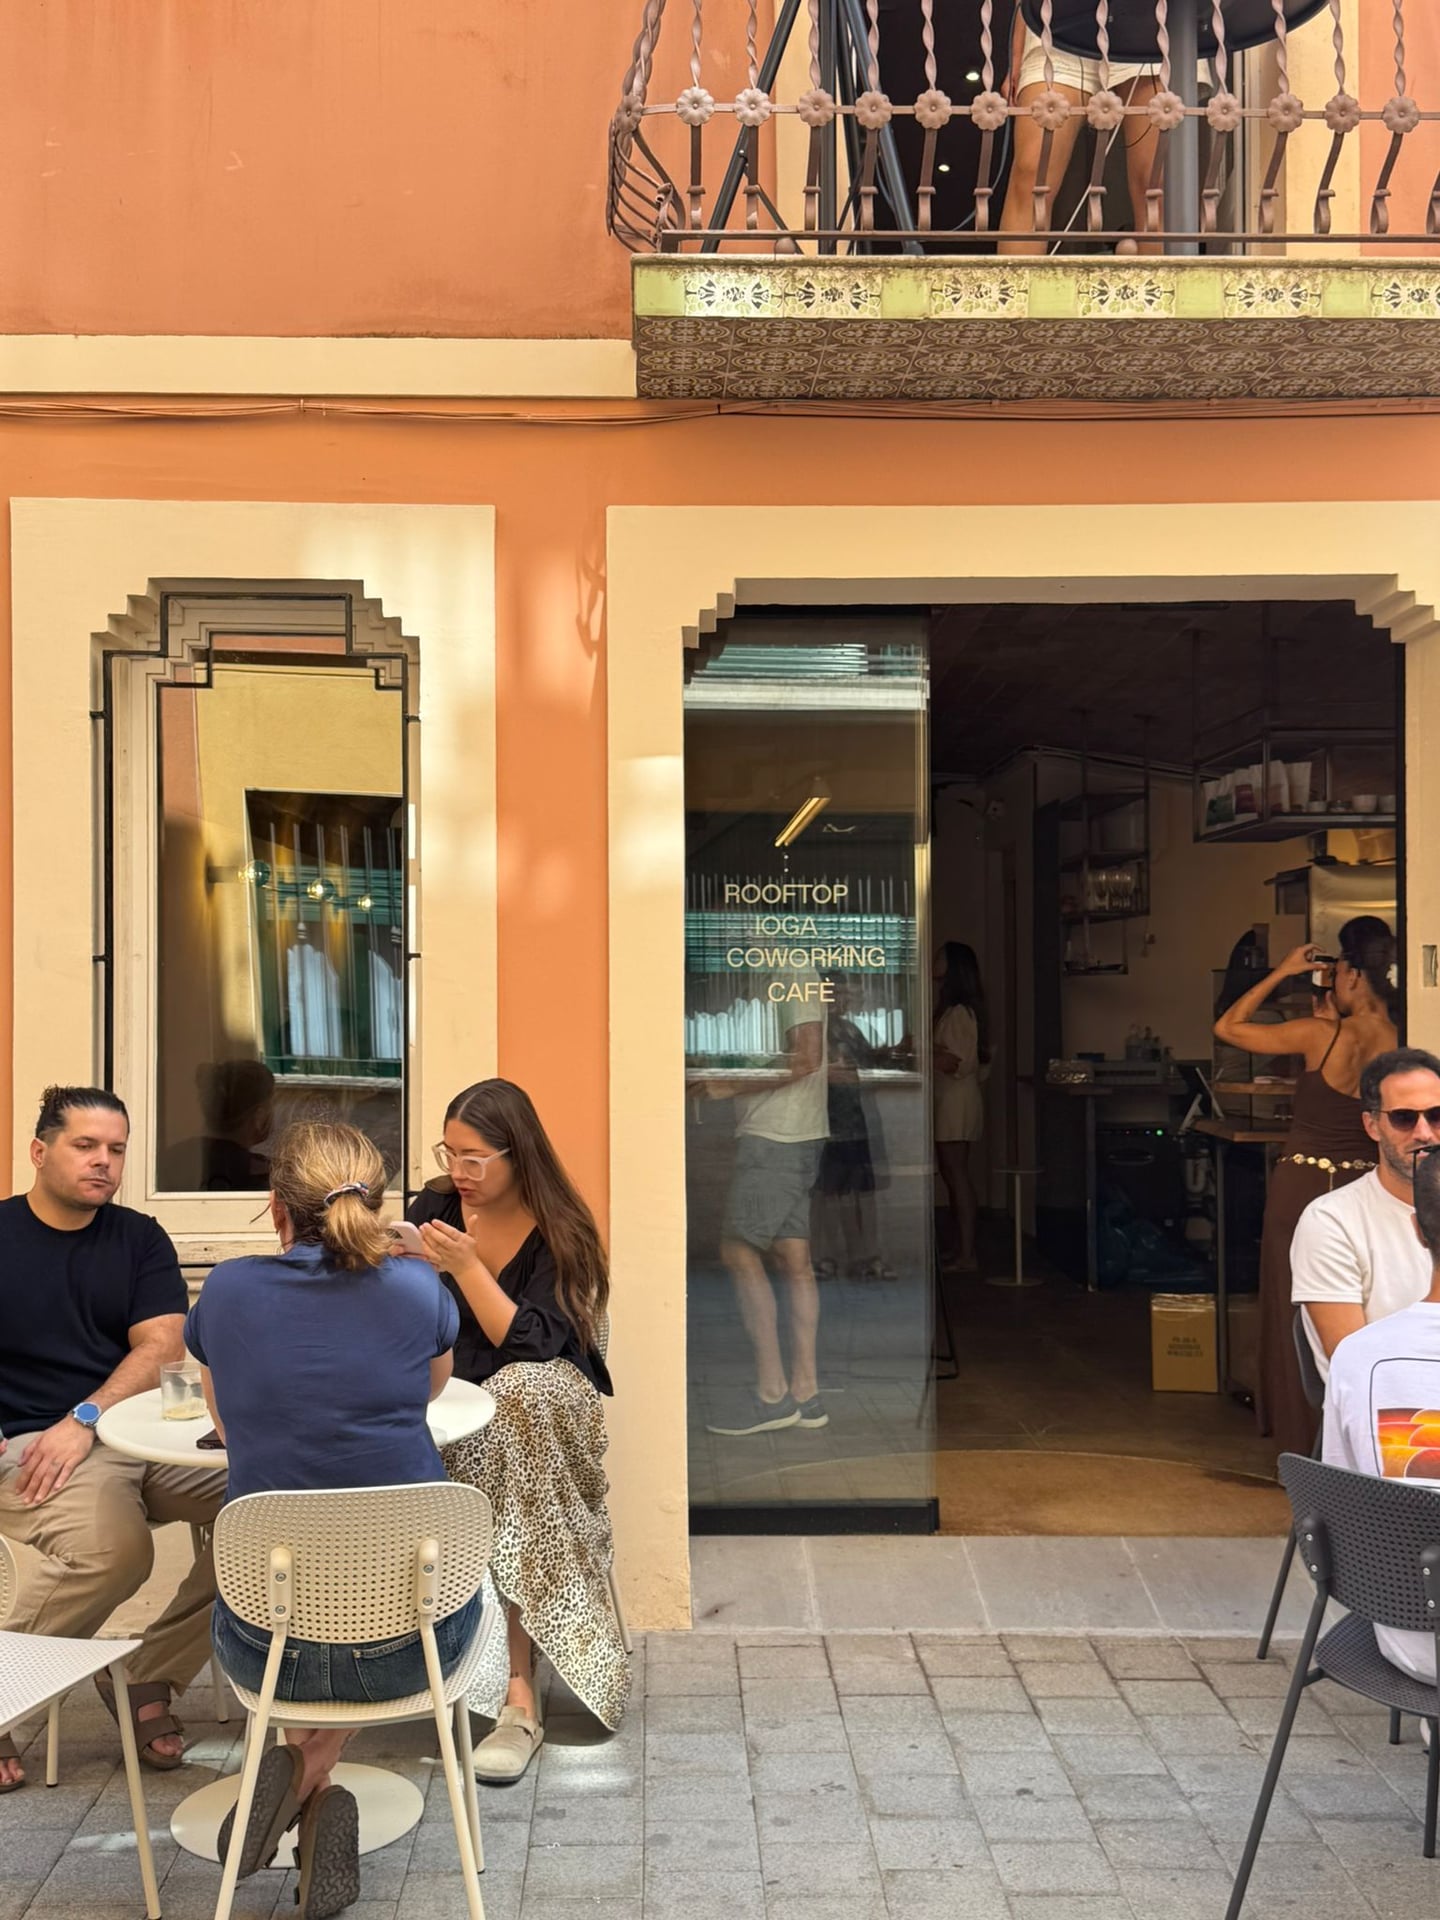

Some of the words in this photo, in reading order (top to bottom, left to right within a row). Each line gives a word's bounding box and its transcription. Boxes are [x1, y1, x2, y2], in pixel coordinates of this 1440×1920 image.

[724, 884, 849, 904] ROOFTOP
[756, 916, 819, 936] IOGA
[726, 947, 886, 968] COWORKING
